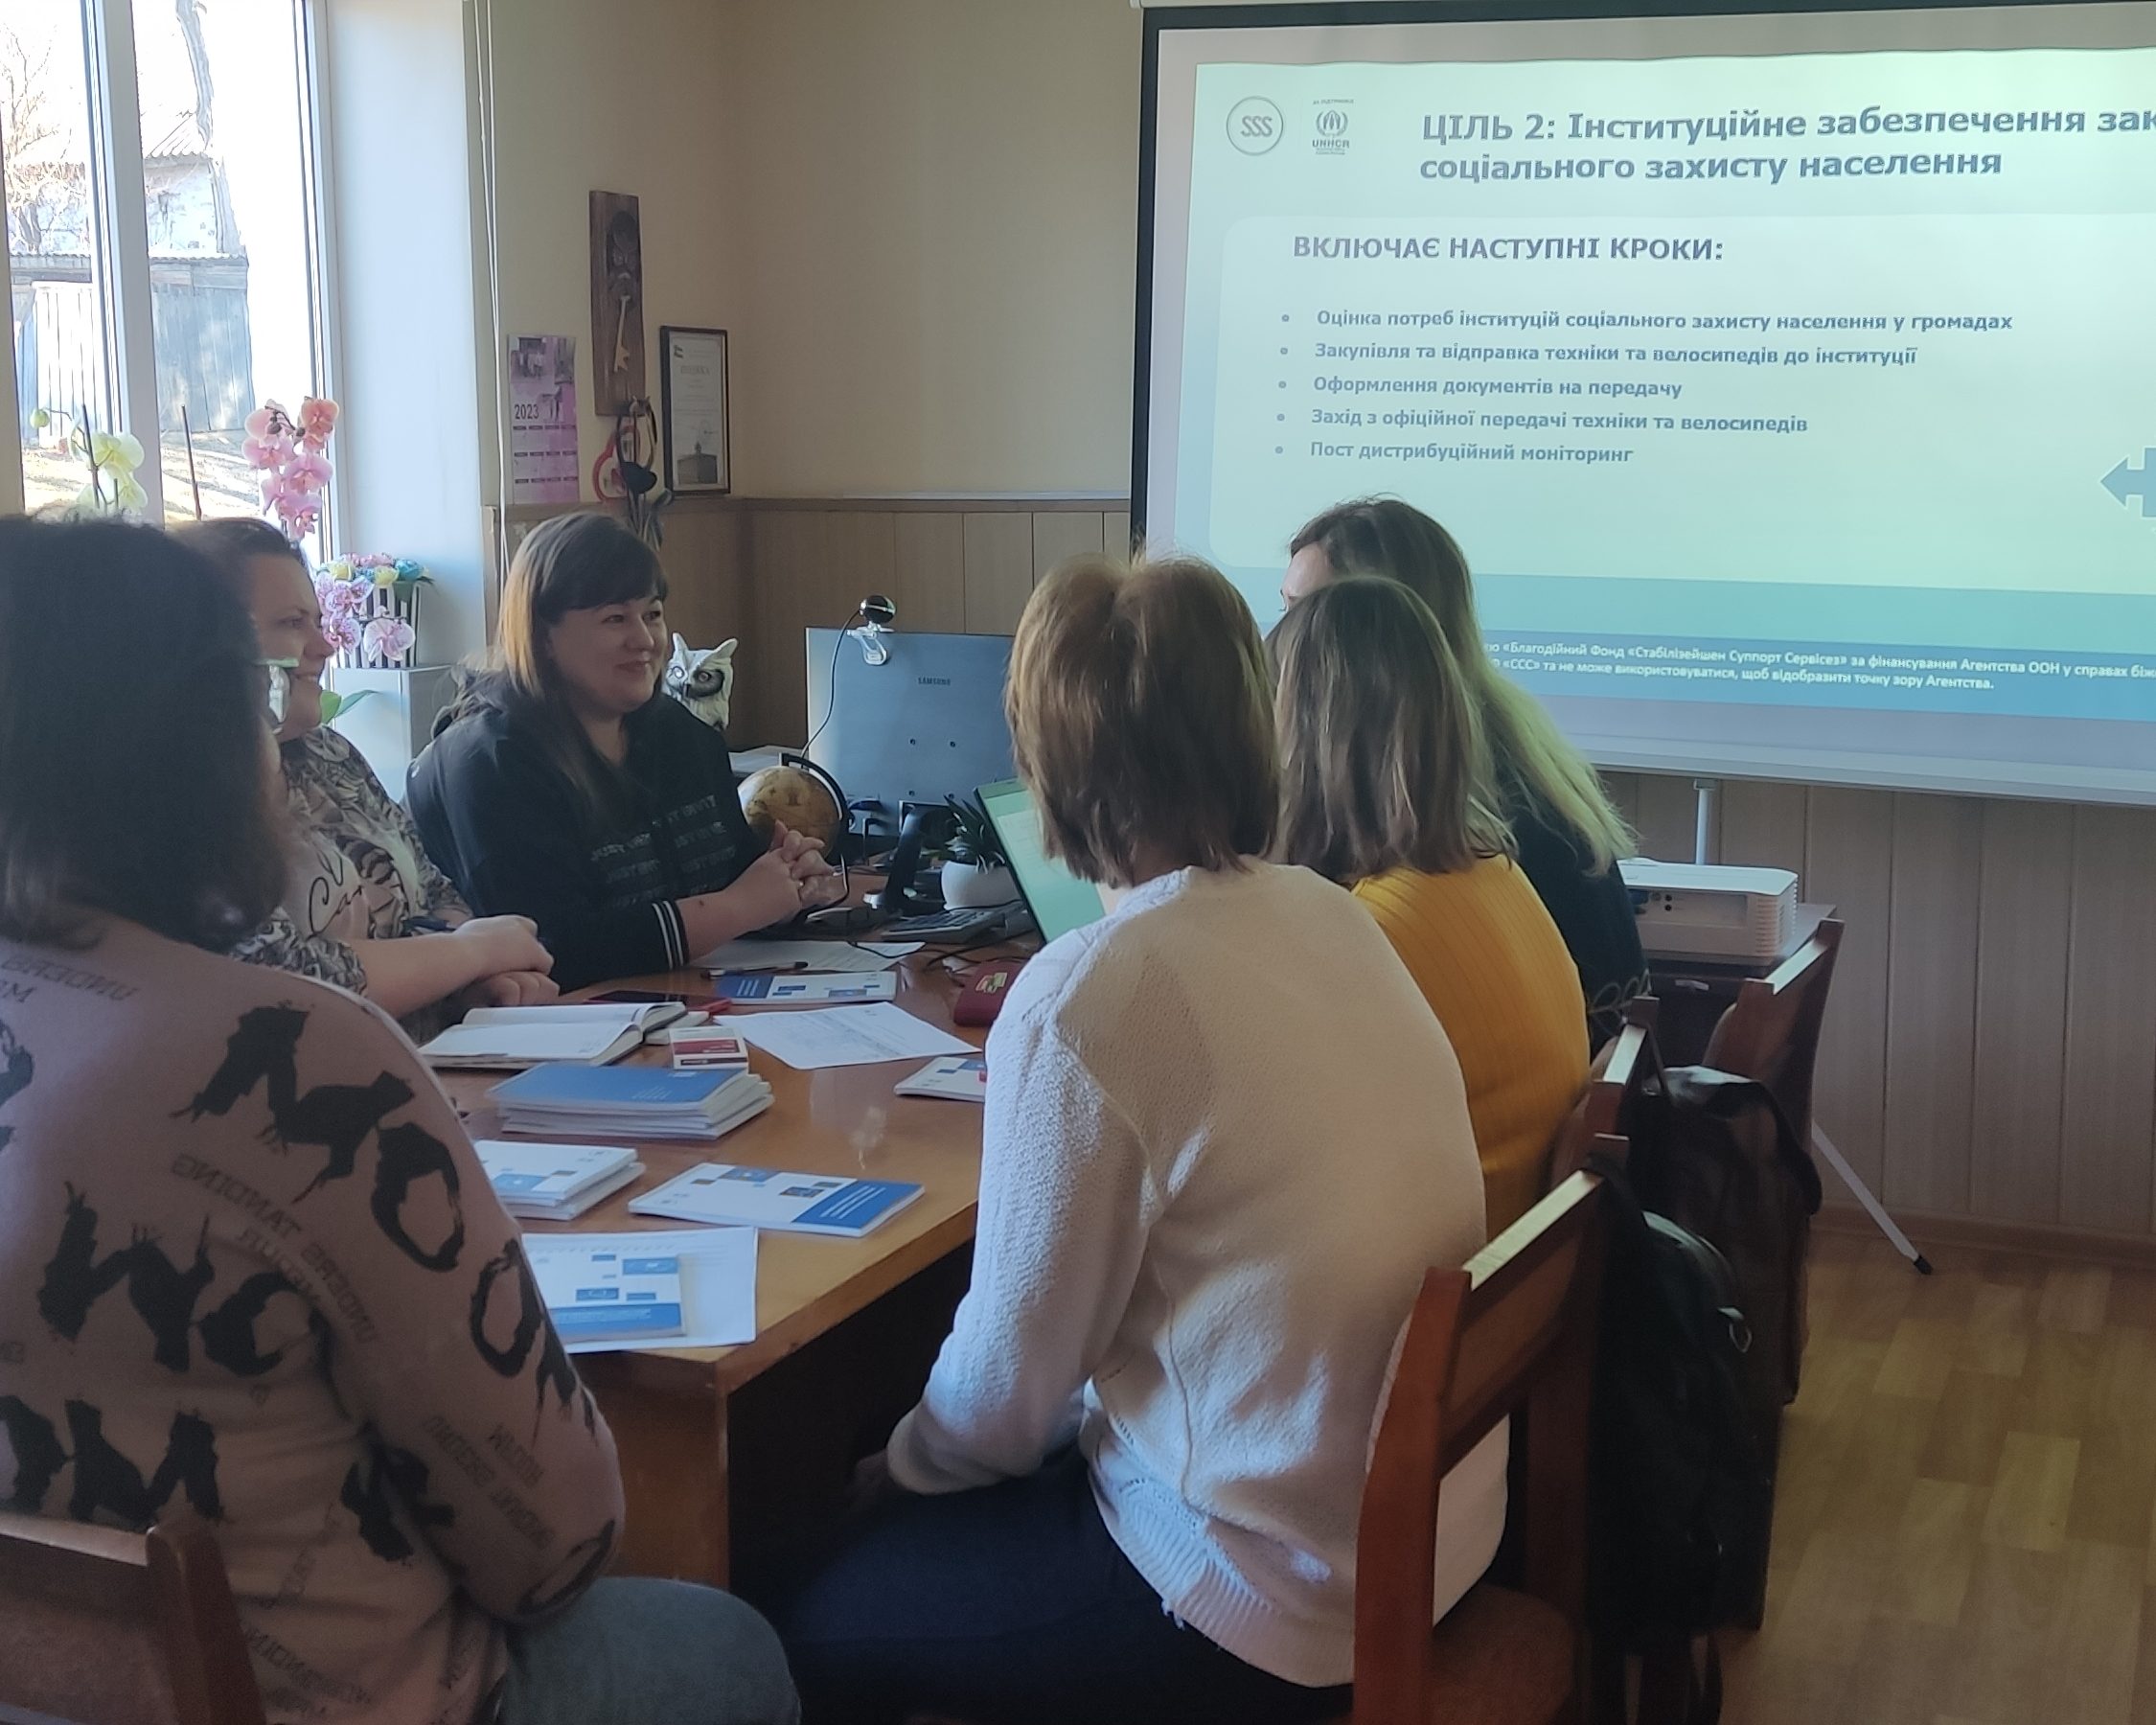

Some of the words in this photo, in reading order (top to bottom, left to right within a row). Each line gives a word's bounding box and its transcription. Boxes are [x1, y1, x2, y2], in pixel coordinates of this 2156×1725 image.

[1423, 113, 1512, 146] ЦІЛЬ
[1525, 113, 1555, 140] 2:
[1568, 107, 1806, 146] Інституційне
[1817, 105, 2085, 135] забезпечення
[1420, 153, 1635, 183] соціального
[1644, 157, 1787, 185] захисту
[1800, 152, 2003, 177] населення
[1294, 236, 1439, 260] ВКЛЮЧАЄ
[1450, 236, 1600, 260] НАСТУПНІ
[1610, 238, 1724, 261] КРОКИ:
[1317, 310, 1381, 328] Оцінка
[1387, 310, 1454, 330] потреб
[1459, 310, 1559, 331] інституцій
[1565, 310, 1686, 330] соціального
[1691, 316, 1770, 333] захисту
[1777, 315, 1886, 330] населення
[1892, 317, 1904, 332] у
[1912, 317, 2013, 333] громадах
[1314, 343, 1411, 362] Закупівля
[1416, 346, 1436, 358] та
[1441, 344, 1539, 364] відправка
[1545, 345, 1619, 360] техніки
[1625, 348, 1646, 360] та
[1652, 347, 1778, 364] велосипедів
[1784, 351, 1809, 364] до
[1816, 347, 1917, 365] інституції
[1313, 376, 1437, 396] Оформлення
[1442, 377, 1553, 396] документів
[1559, 382, 1583, 395] на
[1588, 382, 1682, 400] передачу
[514, 403, 539, 420] 2023
[1311, 409, 1362, 428] Захід
[1366, 413, 1378, 425] з
[1382, 409, 1475, 428] офіційної
[1479, 413, 1567, 431] передачі
[1572, 413, 1647, 429] техніки
[1653, 416, 1674, 429] та
[1681, 414, 1807, 433] велосипедів
[1310, 441, 1354, 458] Пост
[1358, 442, 1515, 463] дистрибуційний
[1520, 446, 1634, 465] моніторинг
[1502, 641, 1588, 656] «Благодійний
[1590, 645, 1625, 658] Фонд
[1730, 650, 1781, 664] Суппорт
[1850, 656, 1866, 667] за
[1869, 655, 1958, 670] фінансування
[1960, 658, 2026, 673] Агентства
[2029, 661, 2060, 675] ООН
[2062, 665, 2072, 677] у
[2075, 665, 2128, 678] справах
[1543, 661, 1556, 671] та
[1557, 662, 1574, 672] не
[1577, 663, 1613, 675] може
[1741, 667, 1769, 680] щоб
[1892, 676, 1923, 688] зору
[1925, 675, 1994, 690] Агентства.
